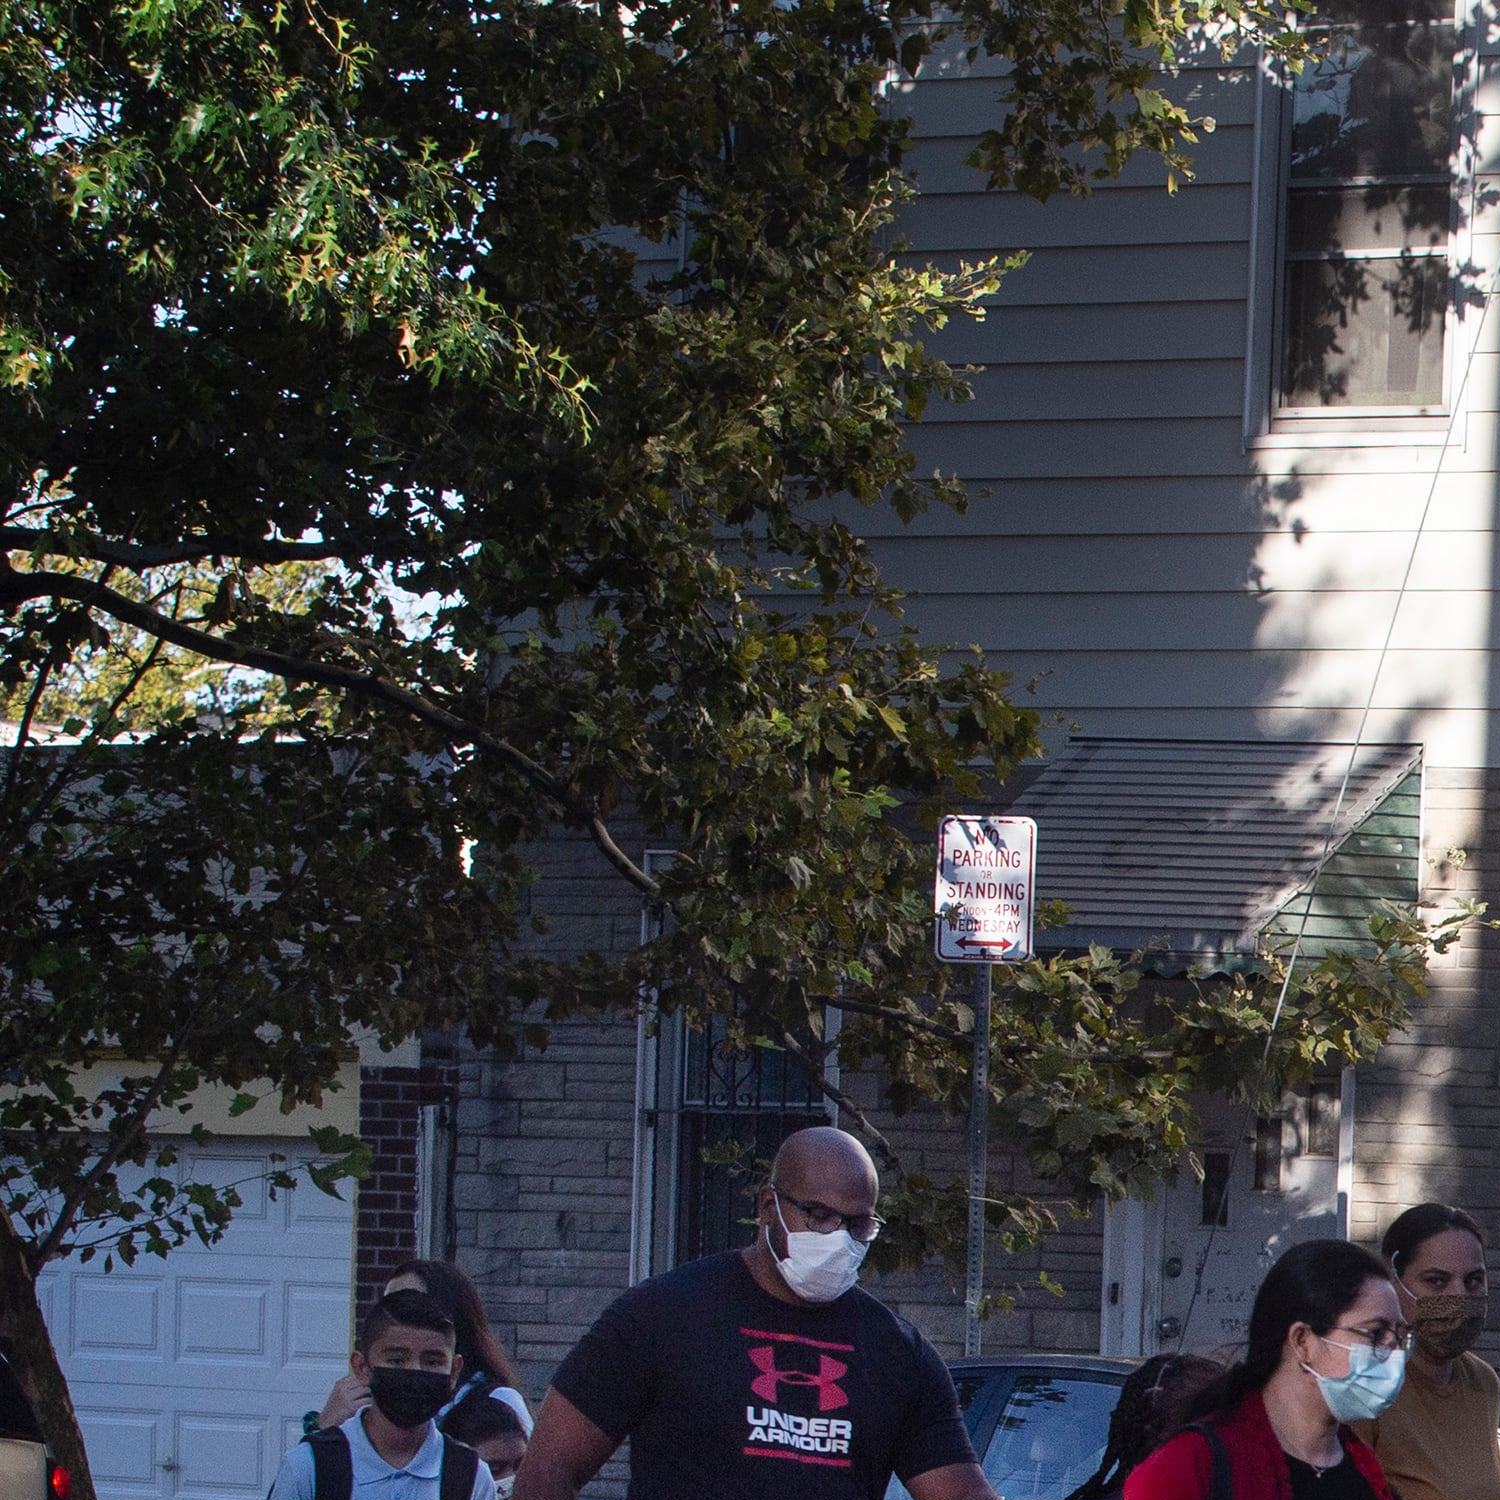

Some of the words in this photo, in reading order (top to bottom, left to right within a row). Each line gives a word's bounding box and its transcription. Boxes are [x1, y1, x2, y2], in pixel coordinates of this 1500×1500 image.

[975, 829, 1000, 846] NO
[952, 849, 1022, 869] PARKING
[980, 869, 993, 881] OR
[946, 881, 1025, 901] STANDING
[746, 1405, 853, 1440] UNDER
[748, 1425, 850, 1454] ARMOUR
